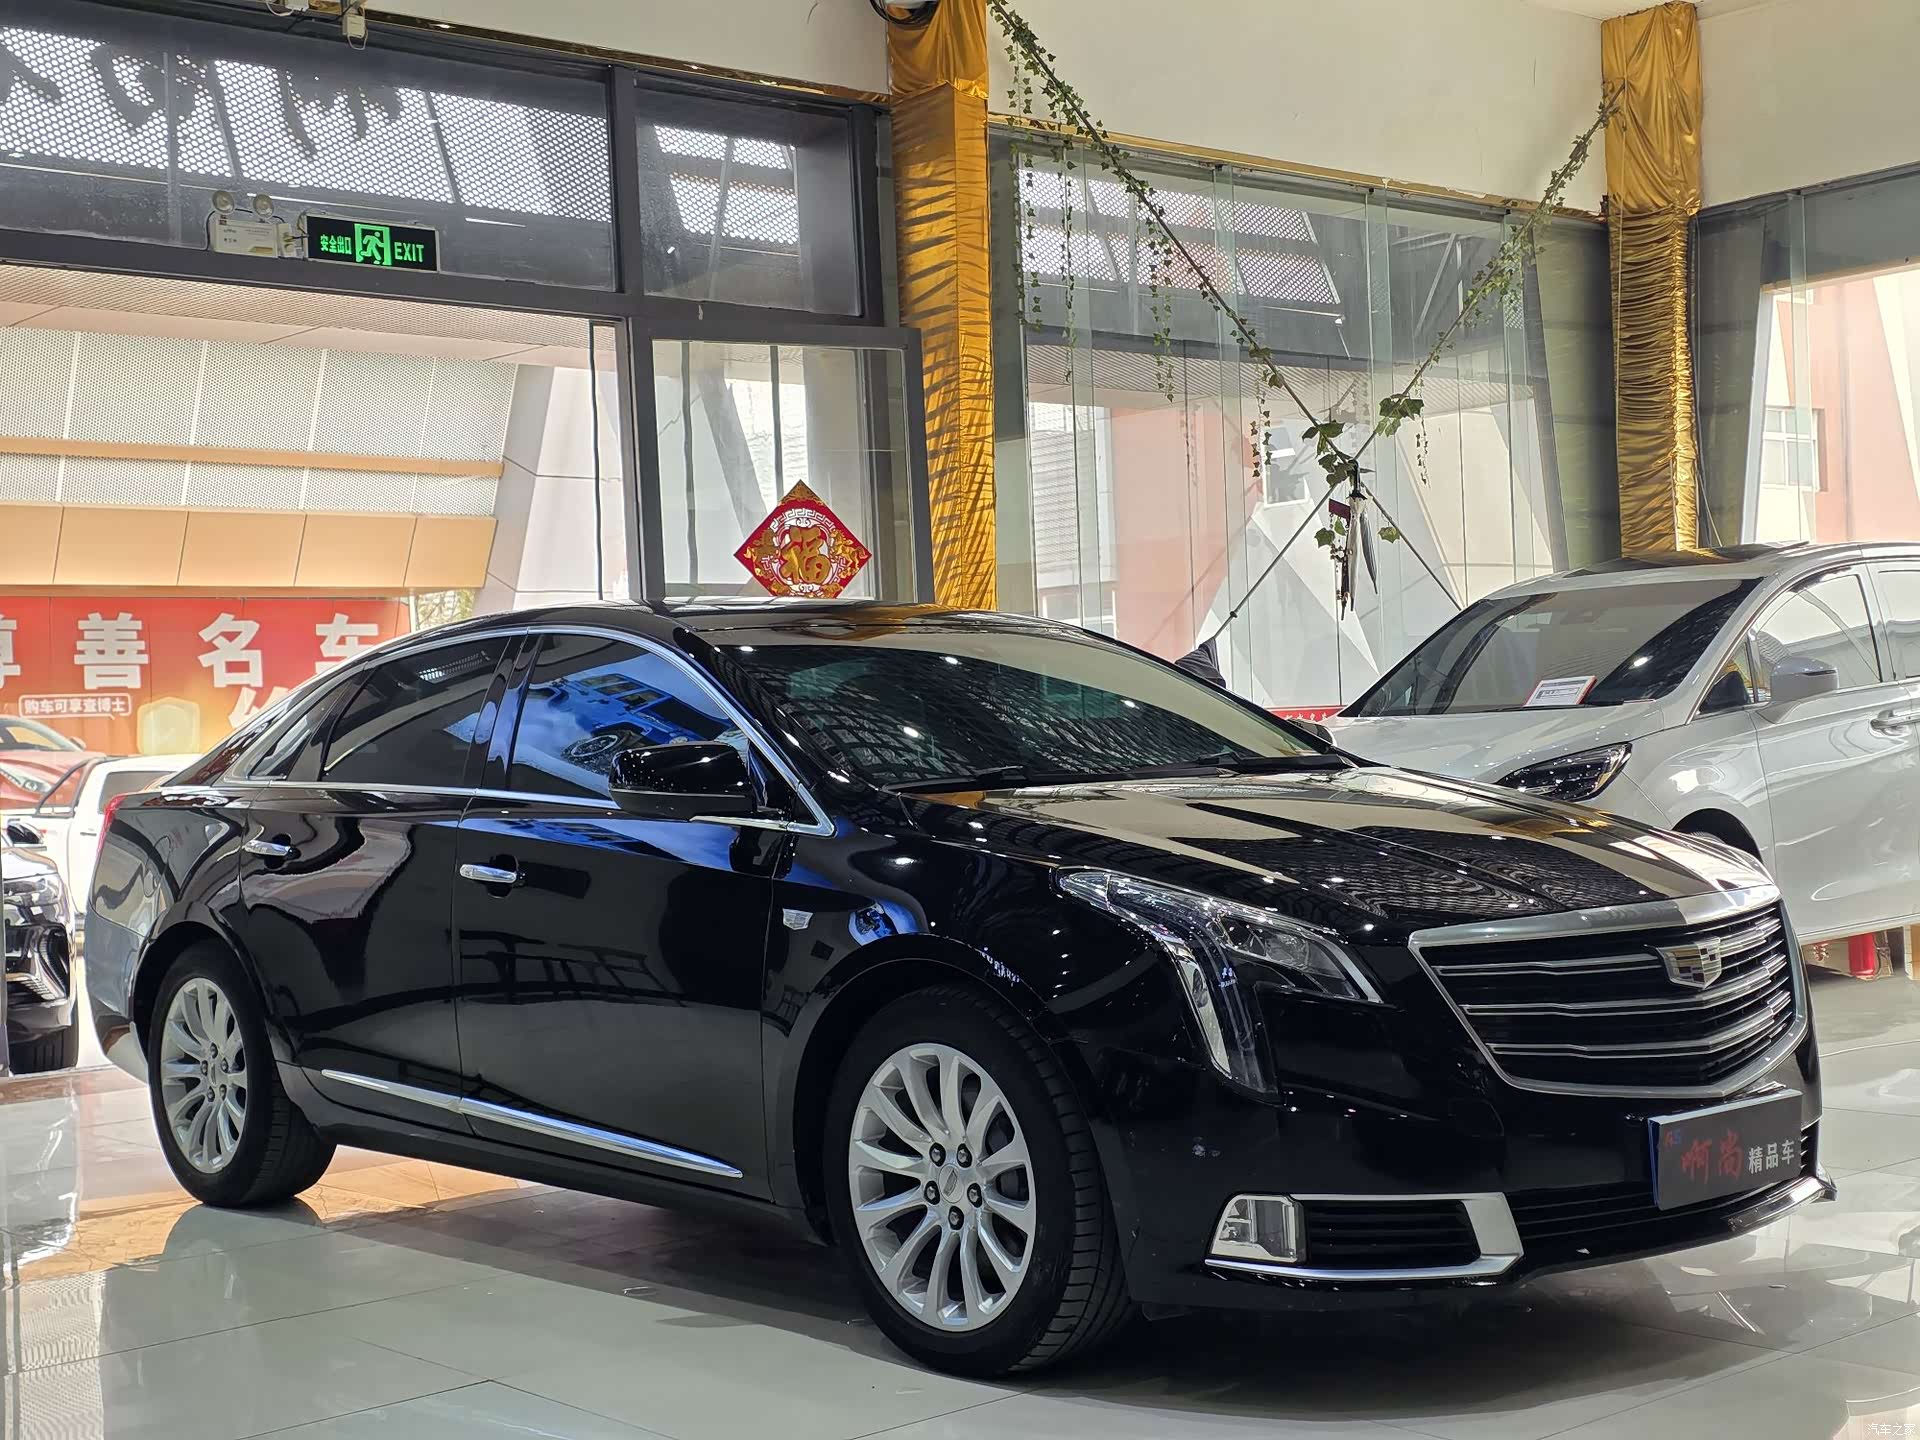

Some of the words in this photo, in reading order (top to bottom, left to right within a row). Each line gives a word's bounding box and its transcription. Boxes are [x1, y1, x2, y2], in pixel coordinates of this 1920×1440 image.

[320, 233, 352, 255] 安全出口
[394, 242, 424, 262] EXIT
[779, 526, 832, 584] 福
[1747, 1139, 1795, 1175] 精品车
